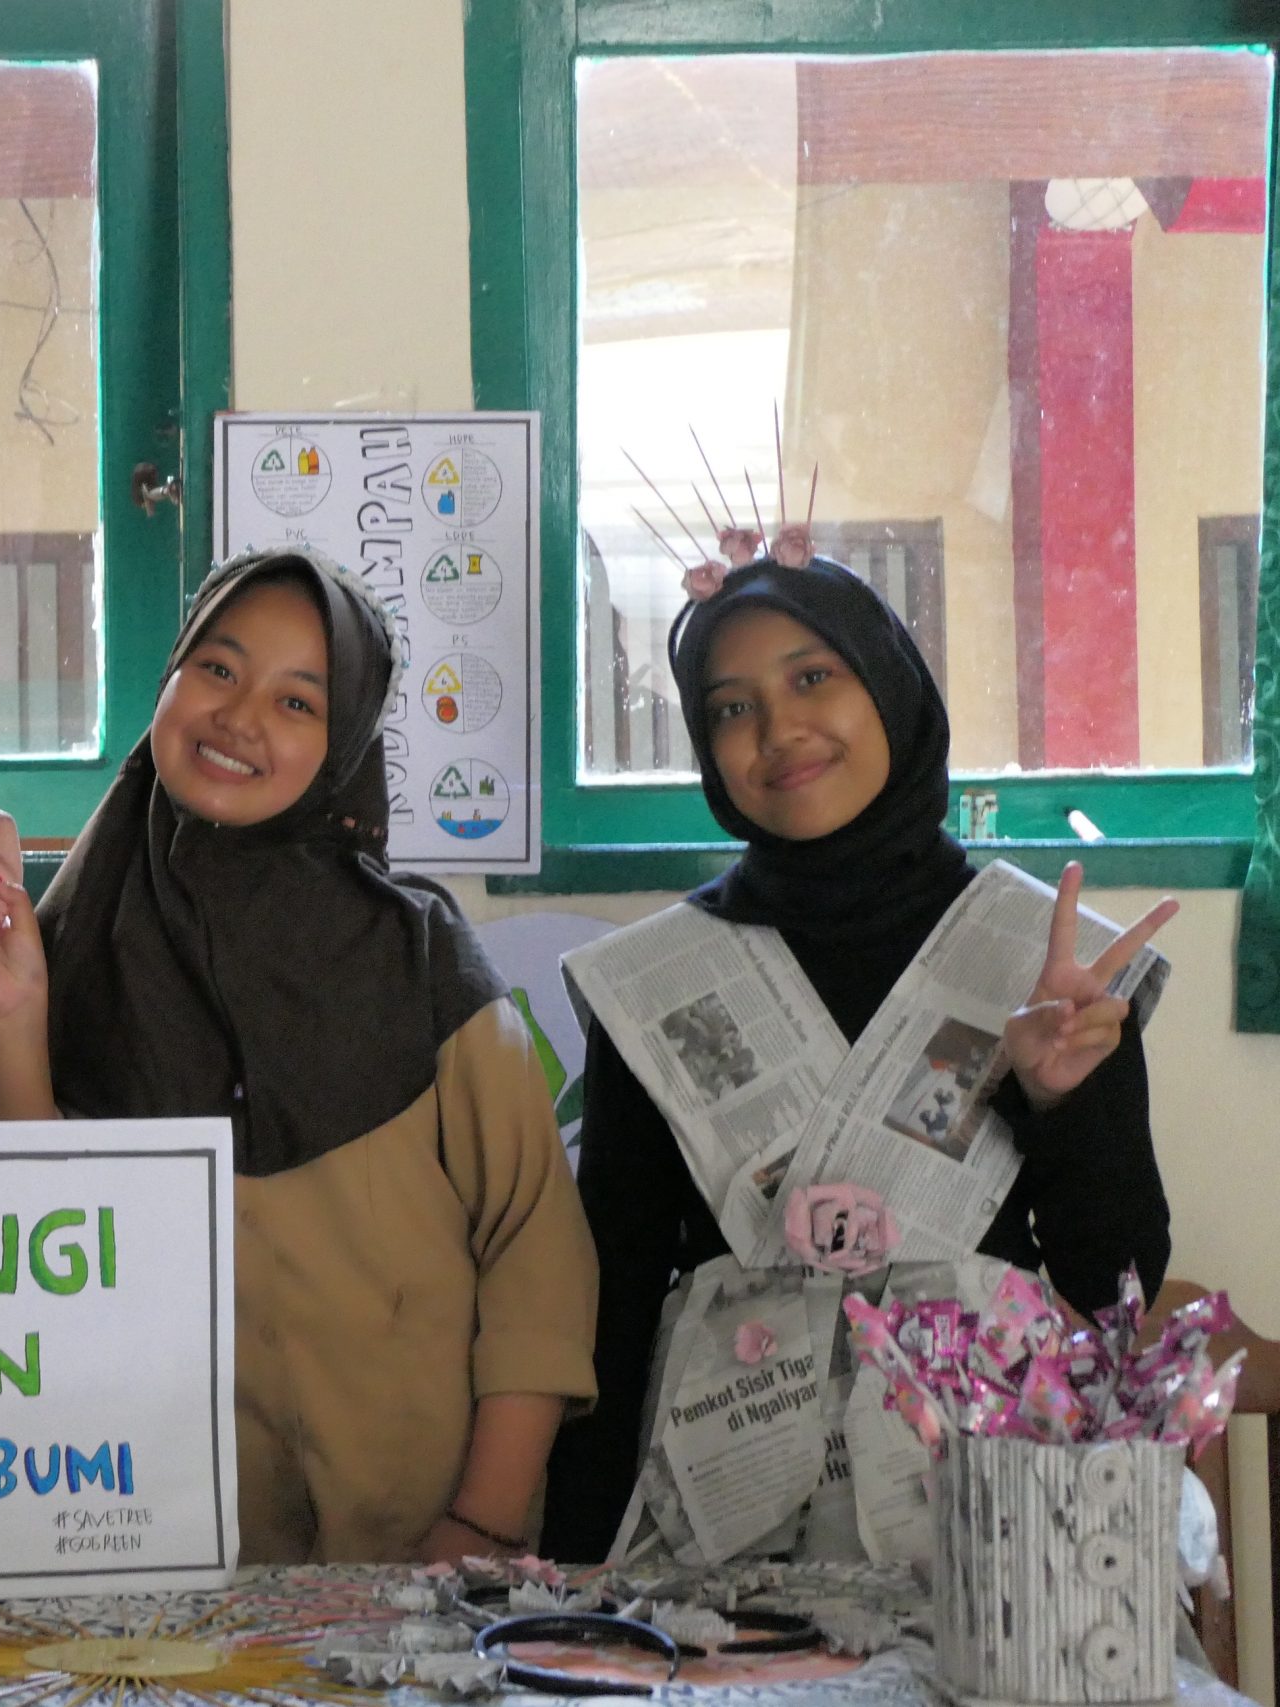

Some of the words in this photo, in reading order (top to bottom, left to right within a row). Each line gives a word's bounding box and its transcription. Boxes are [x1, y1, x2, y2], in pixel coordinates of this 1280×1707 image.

[285, 528, 308, 541] PVC
[670, 1385, 736, 1429] Pemkot
[735, 1368, 775, 1399] Sisir
[776, 1354, 815, 1382] Tiga
[727, 1408, 745, 1433] di
